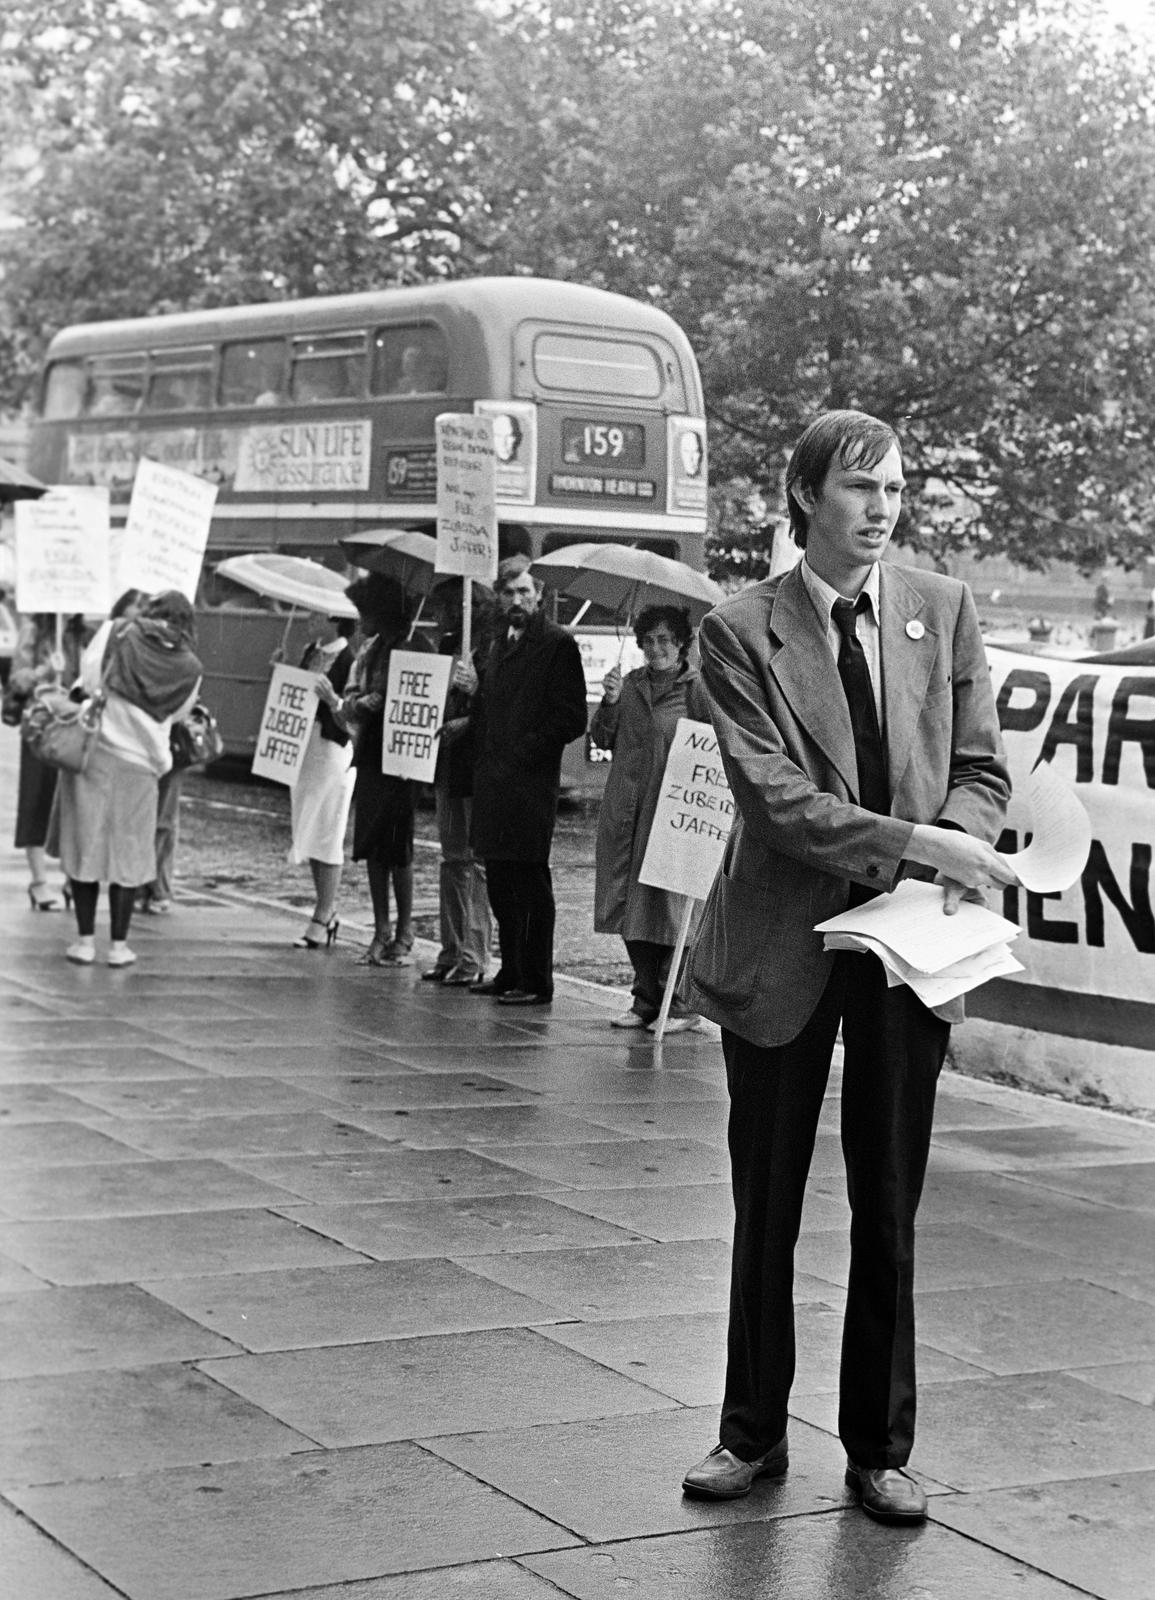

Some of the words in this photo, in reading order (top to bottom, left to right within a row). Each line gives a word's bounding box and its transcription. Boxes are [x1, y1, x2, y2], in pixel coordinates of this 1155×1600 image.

[281, 426, 317, 458] SUN
[323, 424, 362, 457] LIFE
[583, 425, 624, 458] 159
[278, 682, 308, 711] FREE
[399, 670, 433, 698] FREE
[260, 736, 300, 767] JAFFER
[387, 729, 433, 760] JAFFER
[684, 732, 720, 756] NU
[692, 764, 730, 789] FRE
[666, 784, 735, 815] ZUBEID
[670, 812, 729, 843] JAFFE
